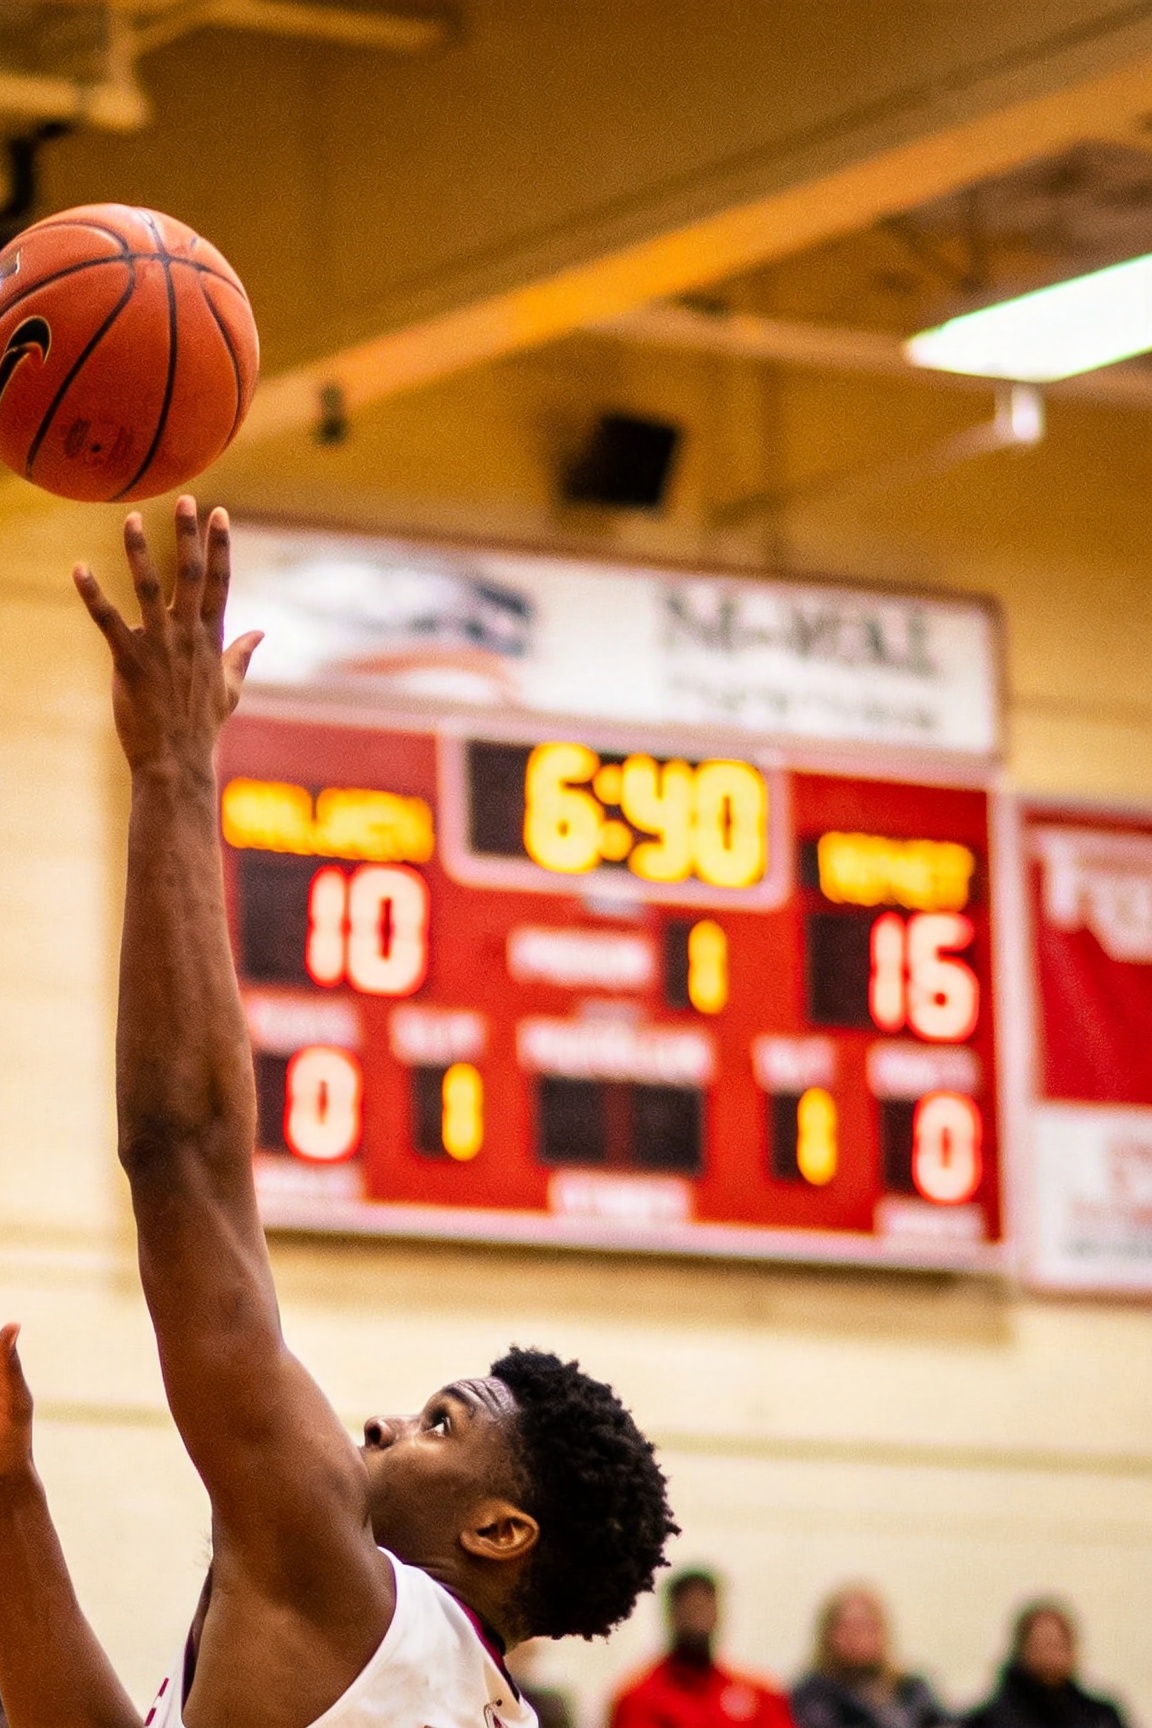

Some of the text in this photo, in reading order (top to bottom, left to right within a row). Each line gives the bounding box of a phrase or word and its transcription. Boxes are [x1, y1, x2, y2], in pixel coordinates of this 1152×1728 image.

[524, 741, 767, 888] 6:40
[306, 864, 431, 998] 10
[869, 911, 980, 1043] 16
[283, 1044, 361, 1163] 0
[912, 1090, 983, 1206] 0
